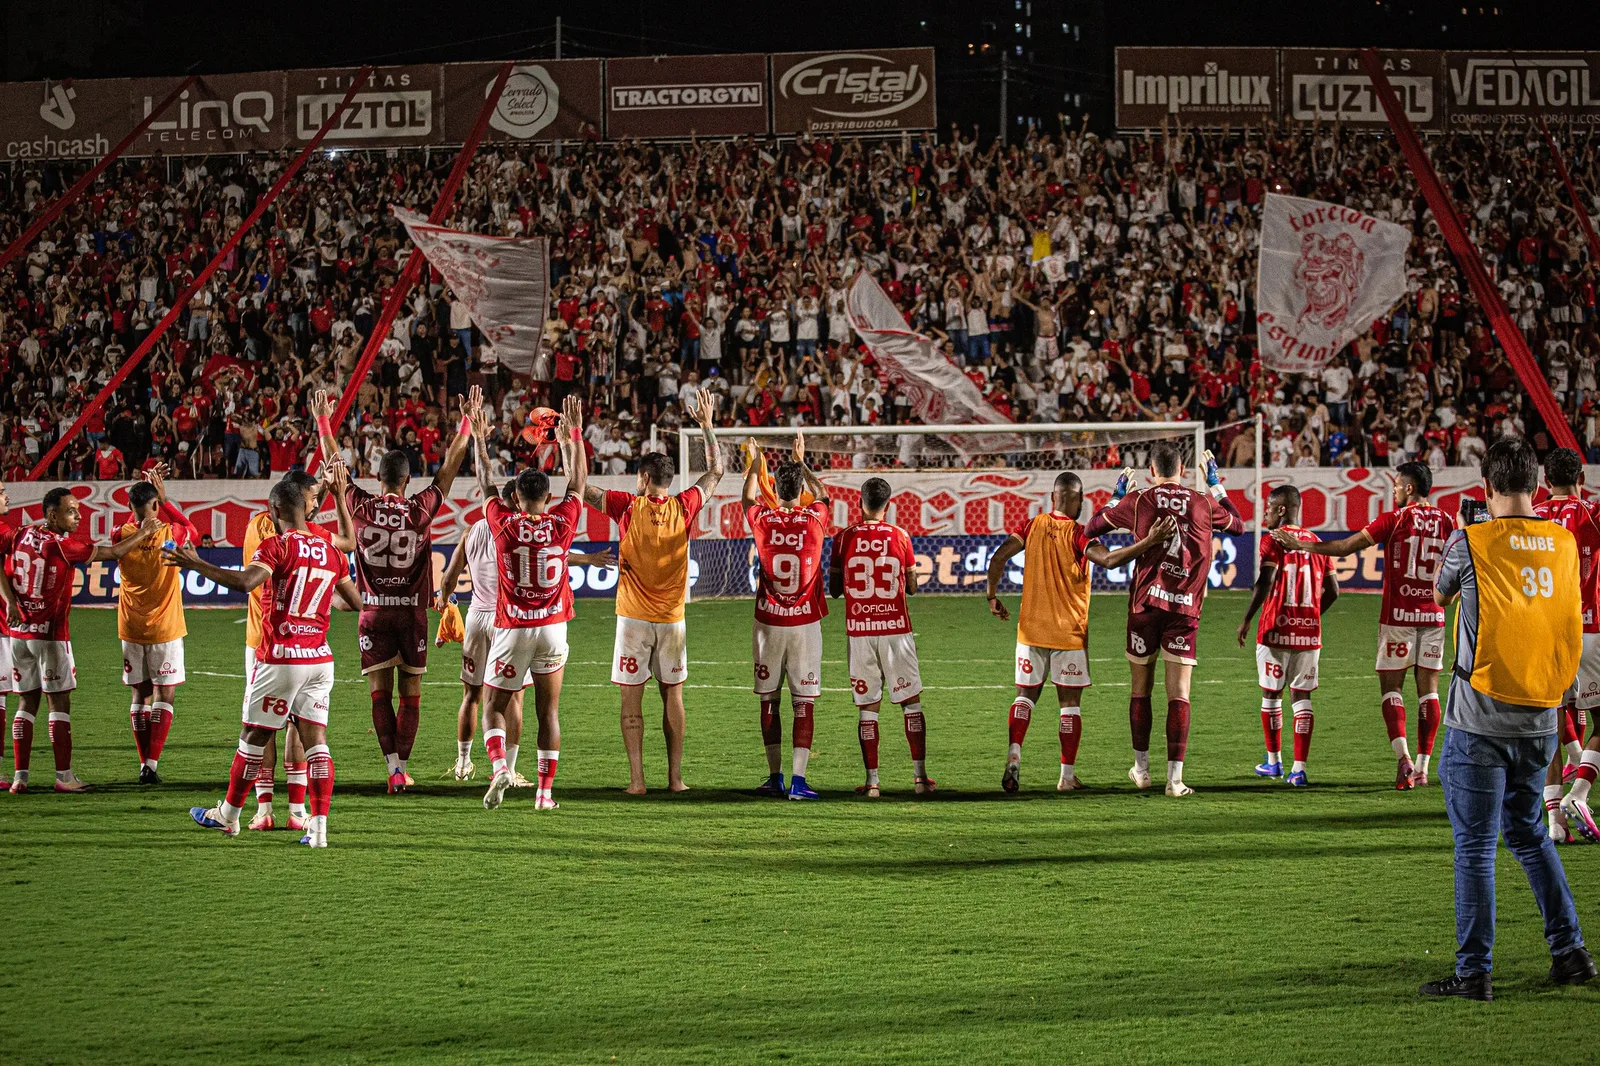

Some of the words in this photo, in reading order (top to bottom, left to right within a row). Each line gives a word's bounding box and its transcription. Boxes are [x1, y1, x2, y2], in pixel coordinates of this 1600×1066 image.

[1315, 57, 1411, 71] TINAS
[793, 65, 919, 96] Cristal
[1123, 63, 1271, 114] Imprilux
[1450, 62, 1600, 106] VEDACIL
[616, 87, 759, 107] TRACTORGYN
[851, 92, 904, 105] PISOS
[144, 128, 253, 142] TELECOM
[811, 119, 899, 131] DISTRIBUIDORA
[7, 133, 109, 158] cashcash
[1157, 494, 1191, 516] bcj
[374, 510, 409, 530] bcj
[1413, 515, 1442, 538] bcj
[363, 525, 418, 569] 29
[518, 525, 553, 547] bcj
[770, 529, 807, 552] bcj
[855, 537, 892, 557] bcj
[1509, 535, 1555, 553] CLUBE
[298, 540, 328, 567] bcj
[1403, 536, 1445, 582] 15
[12, 550, 46, 599] 31
[513, 546, 565, 588] 16
[772, 554, 801, 595] 9
[847, 555, 901, 600] 33
[288, 567, 336, 619] 17
[1282, 563, 1315, 608] 11
[1520, 566, 1555, 599] 39
[757, 597, 812, 617] Unimed
[1147, 585, 1194, 607] nimed
[861, 602, 899, 614] OFICIAL
[846, 615, 906, 632] Unimed
[1130, 633, 1147, 656] F8
[1386, 642, 1408, 660] F8
[495, 658, 517, 680] F8
[619, 656, 639, 675] F8
[1017, 657, 1033, 675] F8
[1265, 662, 1284, 680] F8
[261, 696, 288, 717] F8
